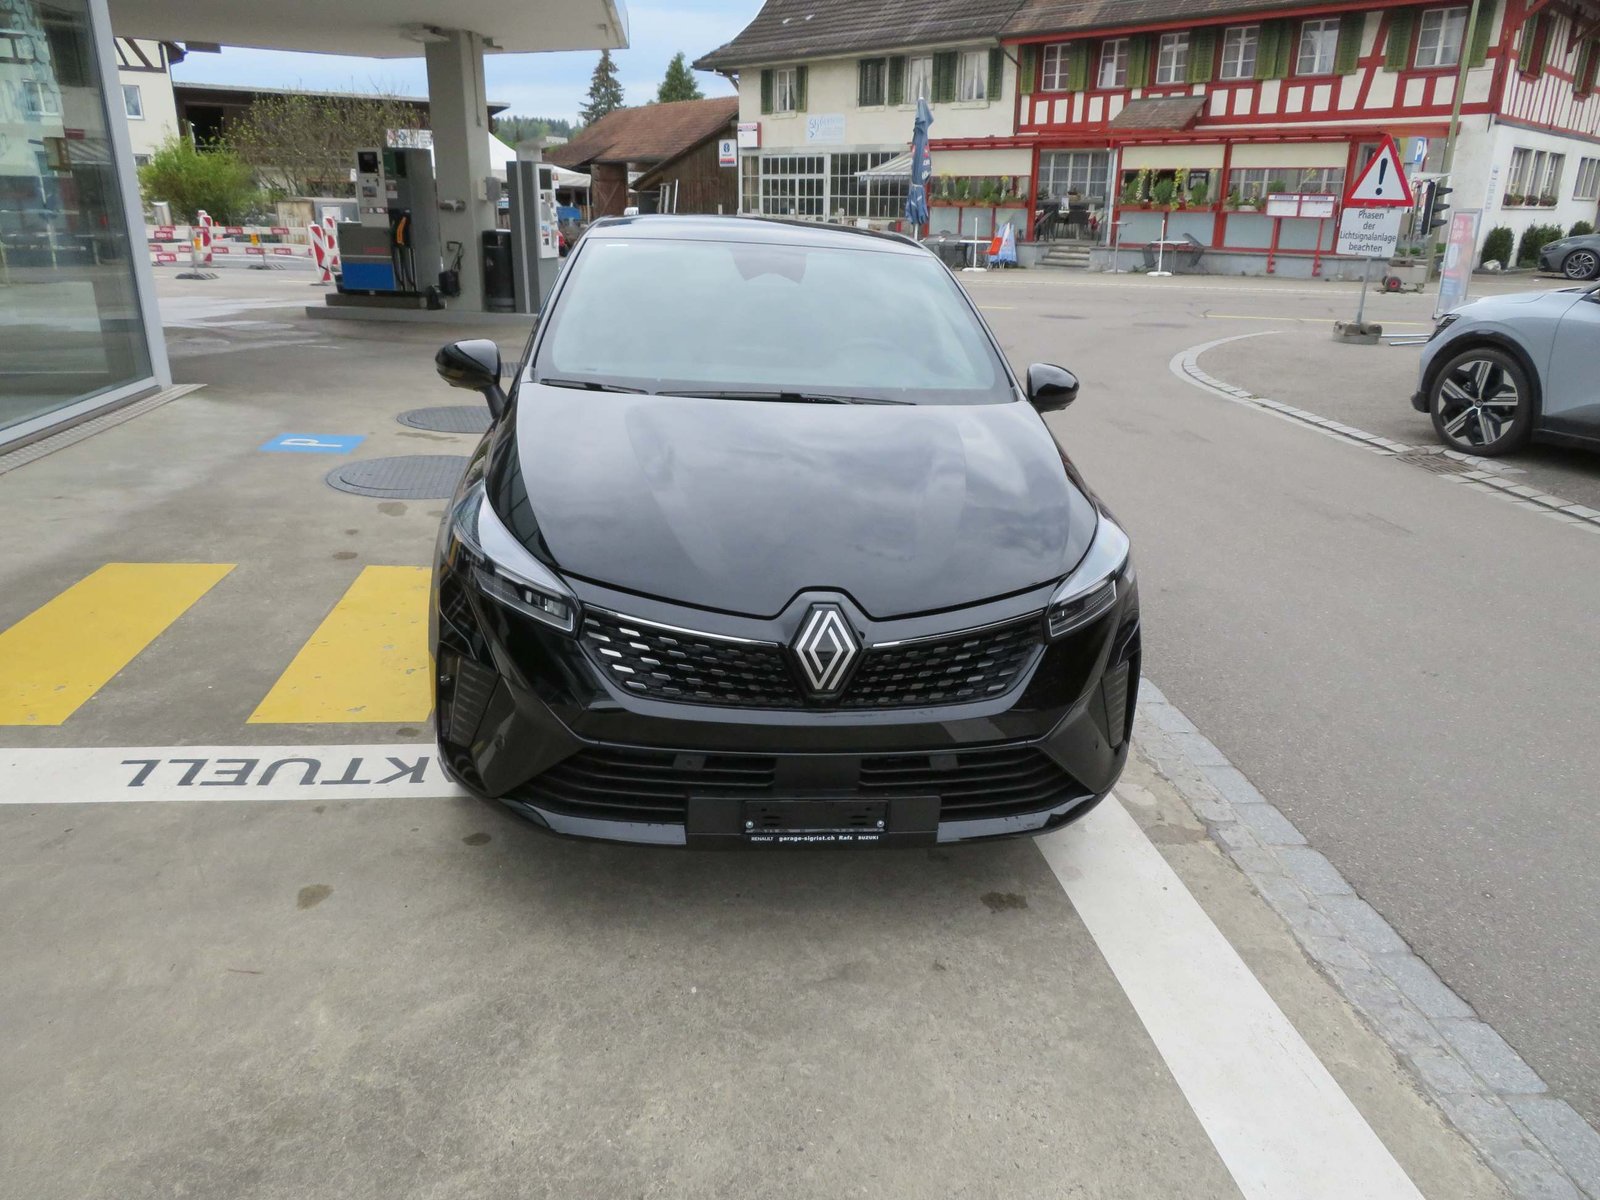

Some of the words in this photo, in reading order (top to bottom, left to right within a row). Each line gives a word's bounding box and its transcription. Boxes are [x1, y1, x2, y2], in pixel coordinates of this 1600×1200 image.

[1414, 140, 1423, 160] P
[1358, 209, 1385, 220] Phasen
[1363, 221, 1376, 230] der
[1340, 231, 1397, 244] Lichtsignalanlage
[1348, 242, 1383, 252] beachten
[121, 756, 457, 788] KTUELL
